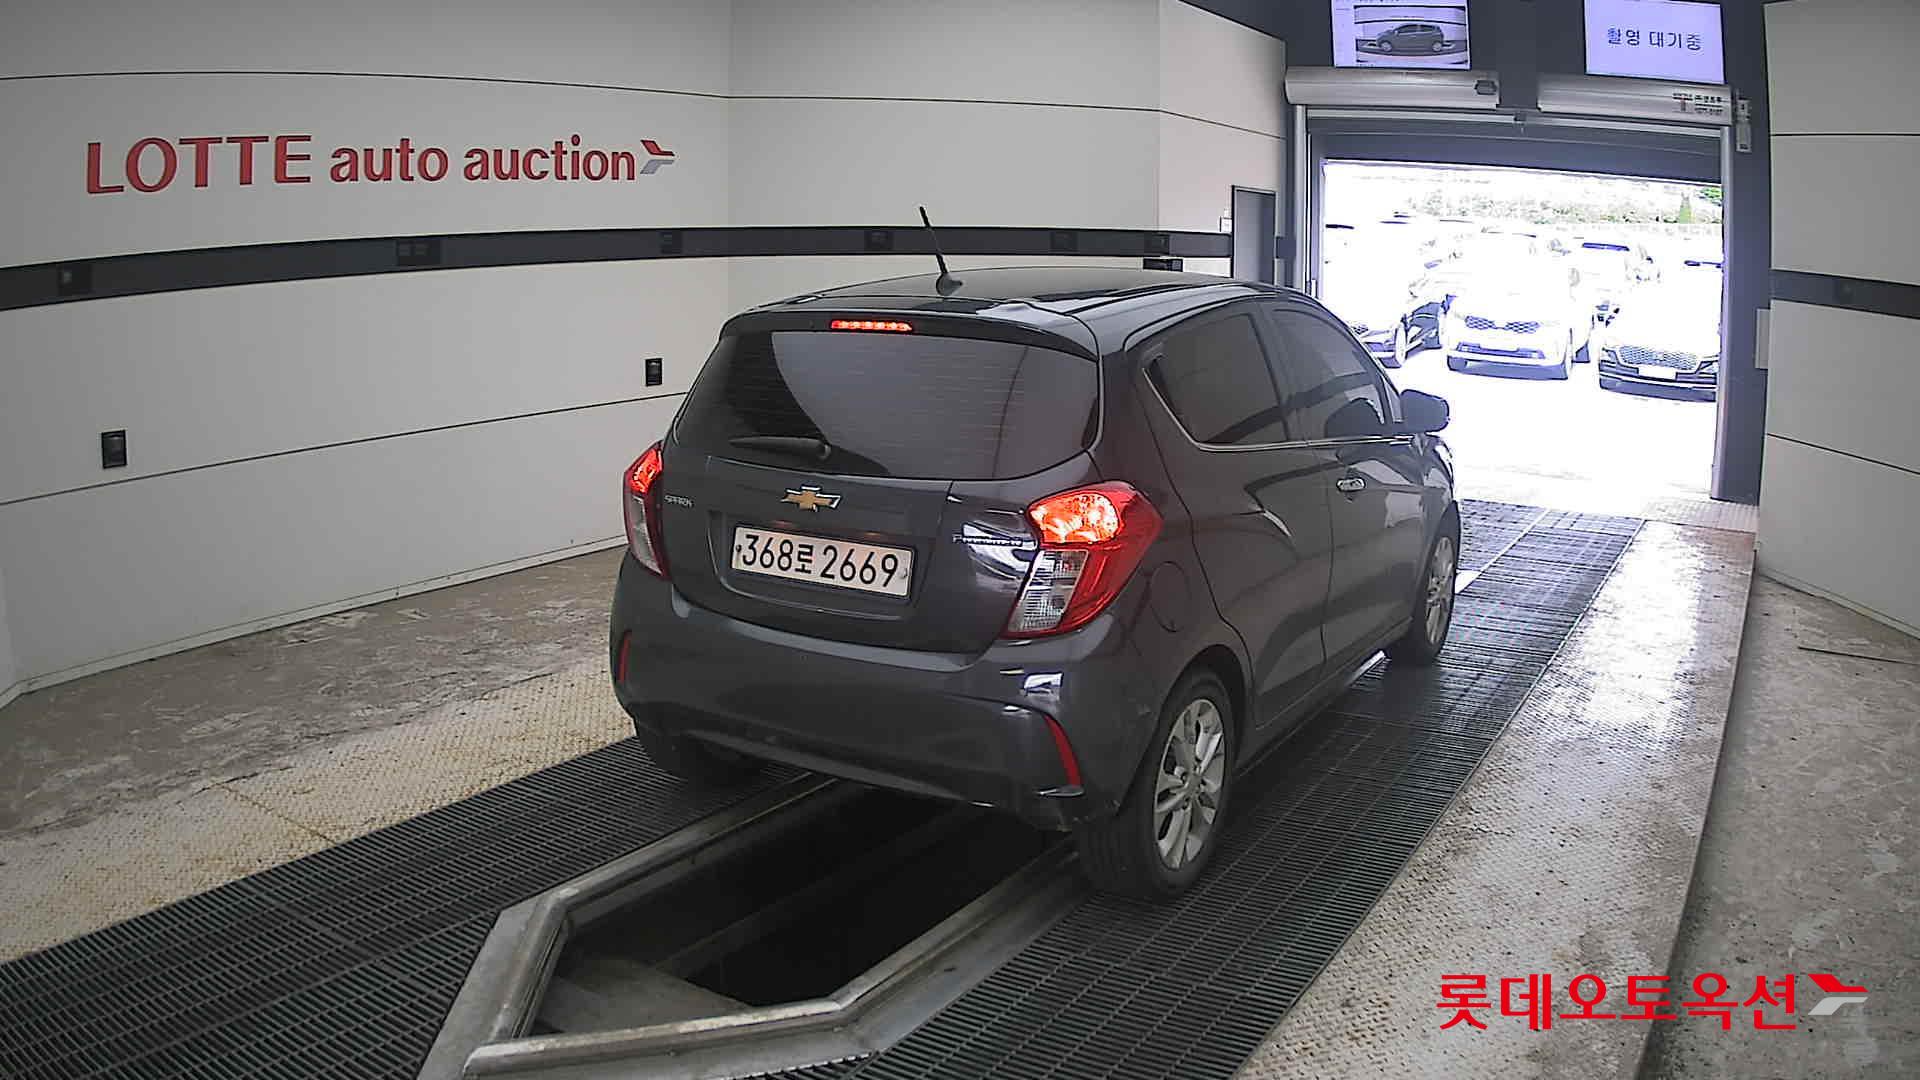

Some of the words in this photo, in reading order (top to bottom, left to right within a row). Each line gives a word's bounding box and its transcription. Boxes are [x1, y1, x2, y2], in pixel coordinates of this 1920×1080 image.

[1649, 31, 1701, 51] 대기중
[86, 134, 313, 194] LOTTE
[329, 138, 449, 182] auto
[463, 134, 636, 182] auction
[742, 534, 814, 574] 368로
[820, 544, 899, 588] 2669
